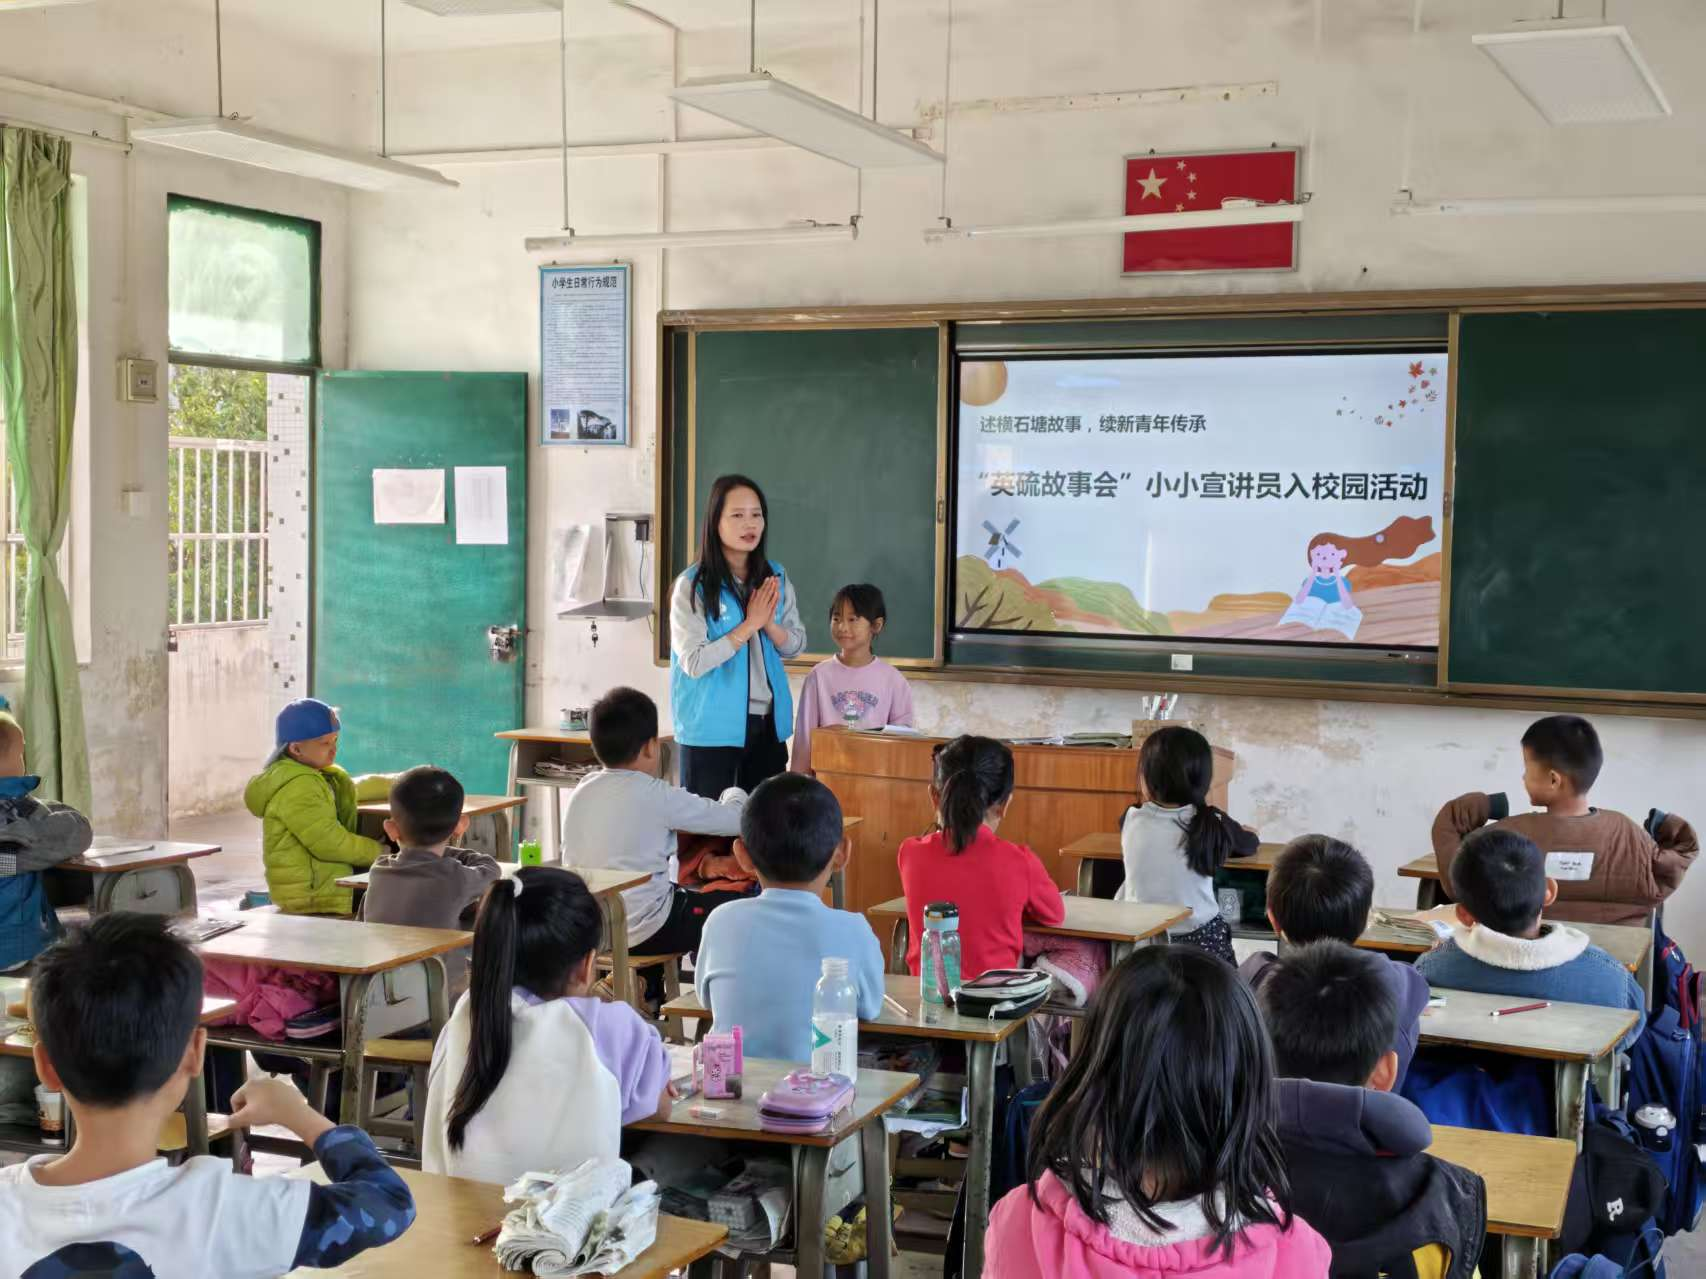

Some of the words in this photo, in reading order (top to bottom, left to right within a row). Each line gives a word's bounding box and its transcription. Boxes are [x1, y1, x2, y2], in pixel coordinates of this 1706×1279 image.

[552, 275, 617, 288] 小学生日常行为规范
[980, 414, 1207, 433] 述横石塘故事，续新青年传承
